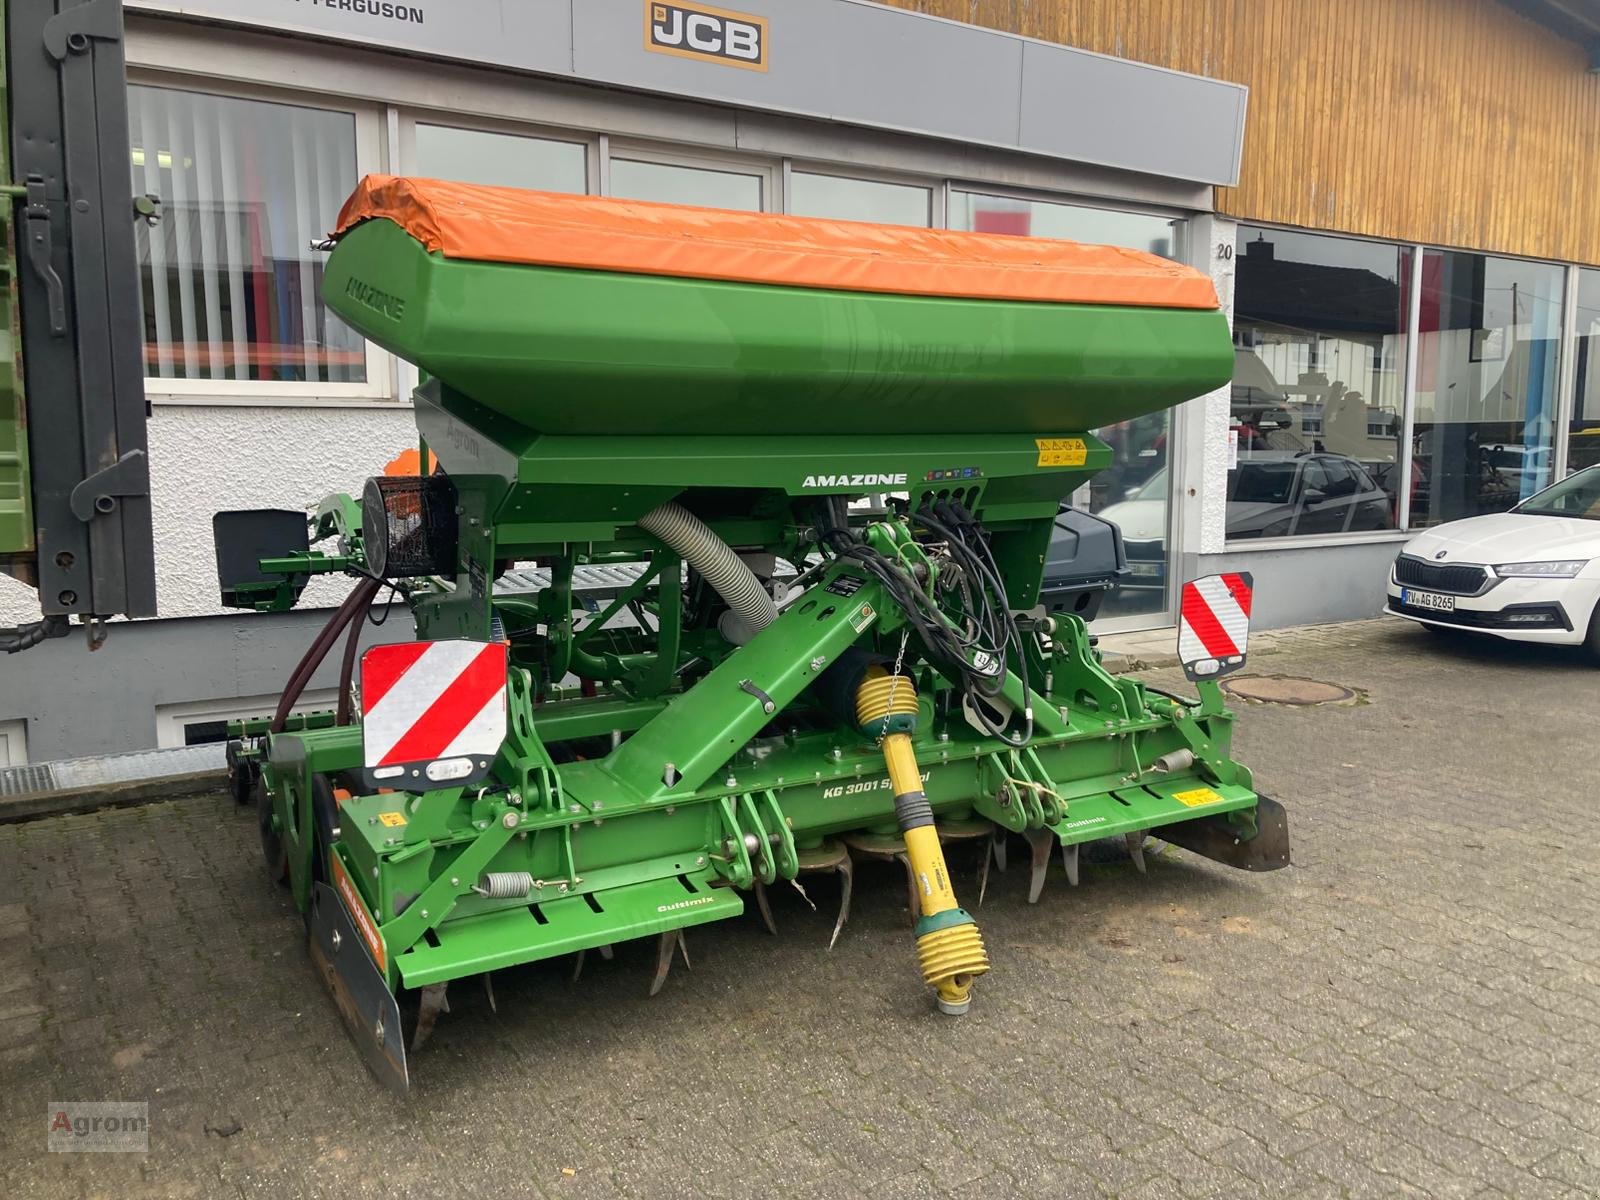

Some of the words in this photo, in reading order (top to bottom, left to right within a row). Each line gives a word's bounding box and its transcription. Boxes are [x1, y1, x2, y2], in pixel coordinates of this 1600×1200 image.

[653, 9, 759, 60] JCB
[1217, 243, 1233, 260] 20
[802, 473, 907, 488] AMAZONE
[1421, 594, 1431, 606] AG
[1432, 595, 1453, 609] 8265
[823, 786, 844, 799] KG
[845, 780, 878, 795] 3001
